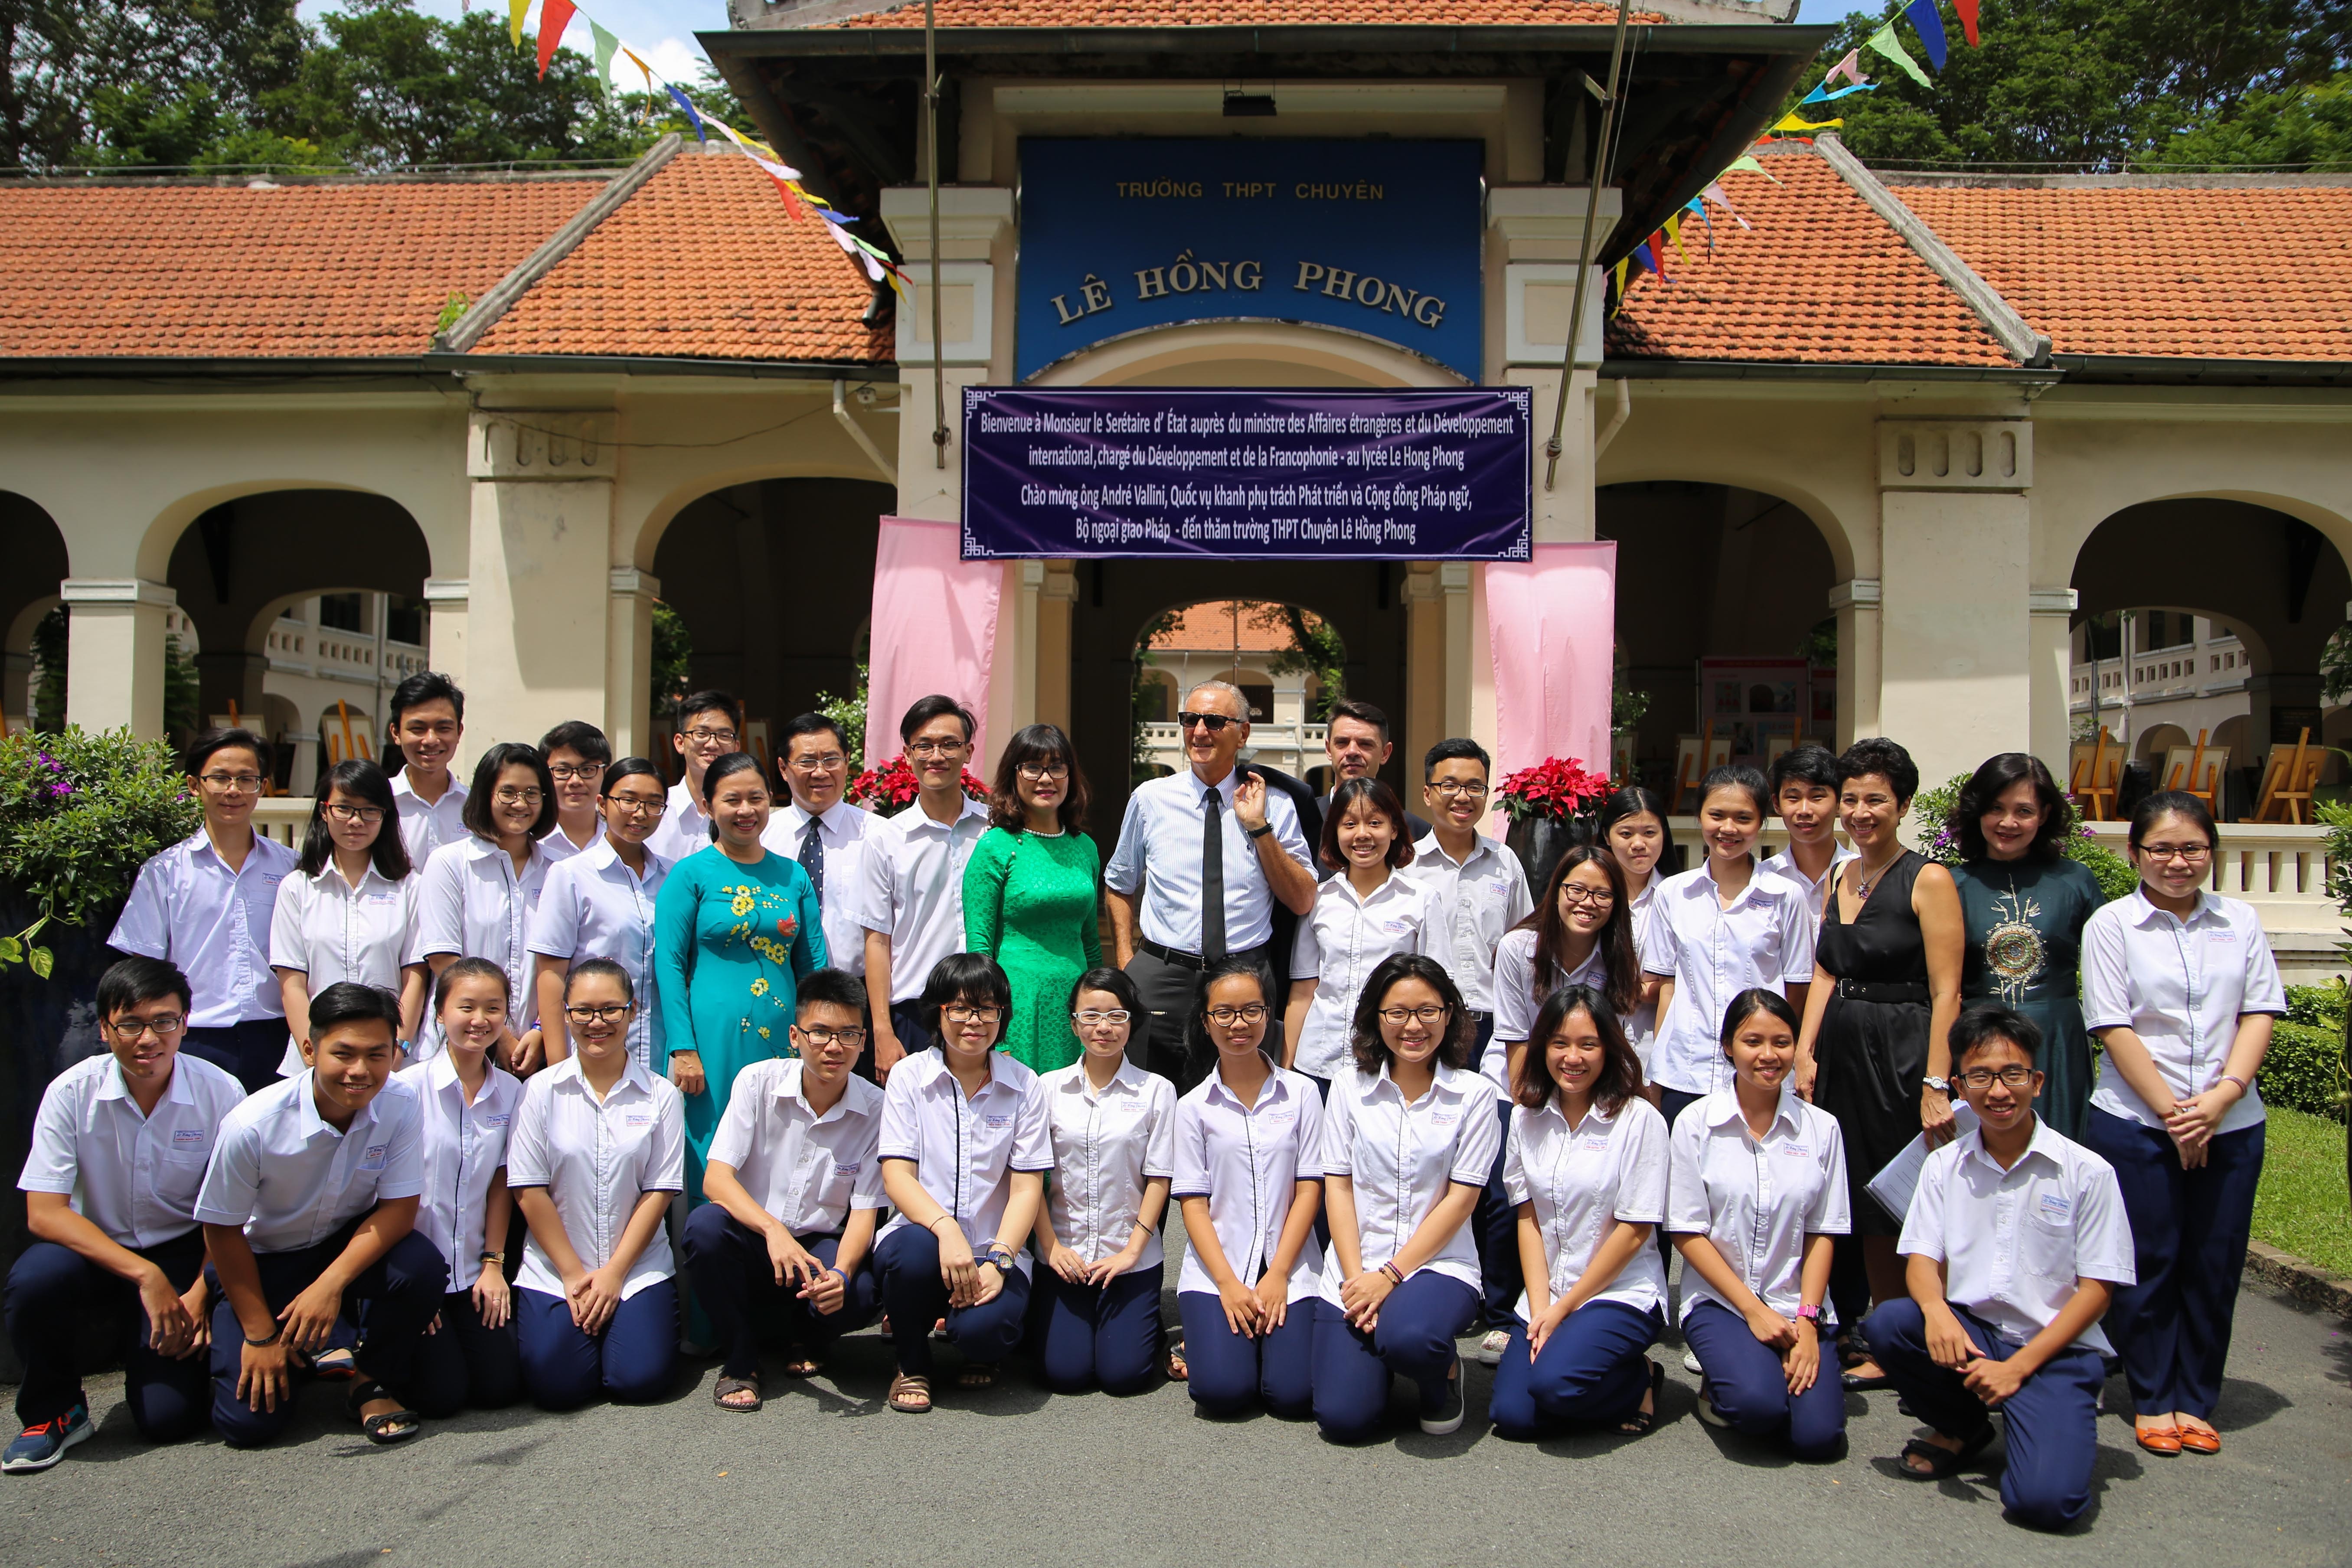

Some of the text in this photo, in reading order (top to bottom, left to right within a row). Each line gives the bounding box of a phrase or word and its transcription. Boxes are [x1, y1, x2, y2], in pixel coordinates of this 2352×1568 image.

[1116, 176, 1383, 199] TRƯỜNG THPT CHUYÊN
[1050, 248, 1446, 328] LÊ HỒNG PHONG
[981, 412, 1032, 433] Bienvenue
[1035, 412, 1041, 433] à
[1043, 412, 1091, 433] Monsieur
[1094, 412, 1102, 433] le
[1106, 412, 1150, 433] Serétaire
[1167, 408, 1187, 433] État
[1191, 412, 1224, 438] auprès
[1228, 412, 1241, 433] du
[1244, 412, 1285, 433] ministre
[1287, 412, 1305, 433] des
[1307, 412, 1346, 433] Affaires
[1349, 412, 1401, 438] étrangères
[1405, 415, 1416, 434] et
[1418, 412, 1431, 433] du
[1434, 412, 1513, 438] Développement
[1132, 445, 1145, 465] du
[1148, 444, 1228, 471] Développement
[1230, 448, 1241, 466] et
[1243, 445, 1255, 466] de
[1258, 445, 1267, 466] la
[1270, 445, 1338, 471] Francophonie
[1347, 451, 1359, 466] au
[1362, 444, 1387, 471] lycée
[1390, 446, 1401, 466] Le
[1404, 446, 1430, 471] Hong
[1433, 445, 1464, 471] Phong
[1021, 483, 1046, 505] Chào
[1049, 484, 1078, 510] mừng
[1081, 483, 1099, 510] ông
[1101, 483, 1132, 505] André
[1134, 484, 1168, 509] Vallini,
[1170, 482, 1197, 508] Quốc
[1199, 490, 1212, 510] vụ
[1214, 484, 1245, 506] khanh
[1248, 484, 1267, 511] phụ
[1270, 484, 1296, 506] trách
[1299, 484, 1322, 506] Phát
[1324, 481, 1348, 506] triển
[1350, 484, 1362, 506] và
[1365, 484, 1390, 511] Cộng
[1393, 482, 1418, 511] đồng
[1421, 484, 1446, 511] Pháp
[1076, 516, 1089, 543] Bộ
[1092, 517, 1119, 543] ngoại
[1121, 518, 1143, 543] giao
[1145, 517, 1170, 543] Pháp
[1182, 515, 1201, 539] đến
[1204, 517, 1230, 539] thăm
[1233, 517, 1270, 544] trường
[1271, 519, 1299, 539] THPT
[1301, 517, 1338, 544] Chuyên
[1341, 517, 1352, 539] Lê
[1355, 515, 1382, 545] Hồng
[1384, 518, 1416, 545] Phong
